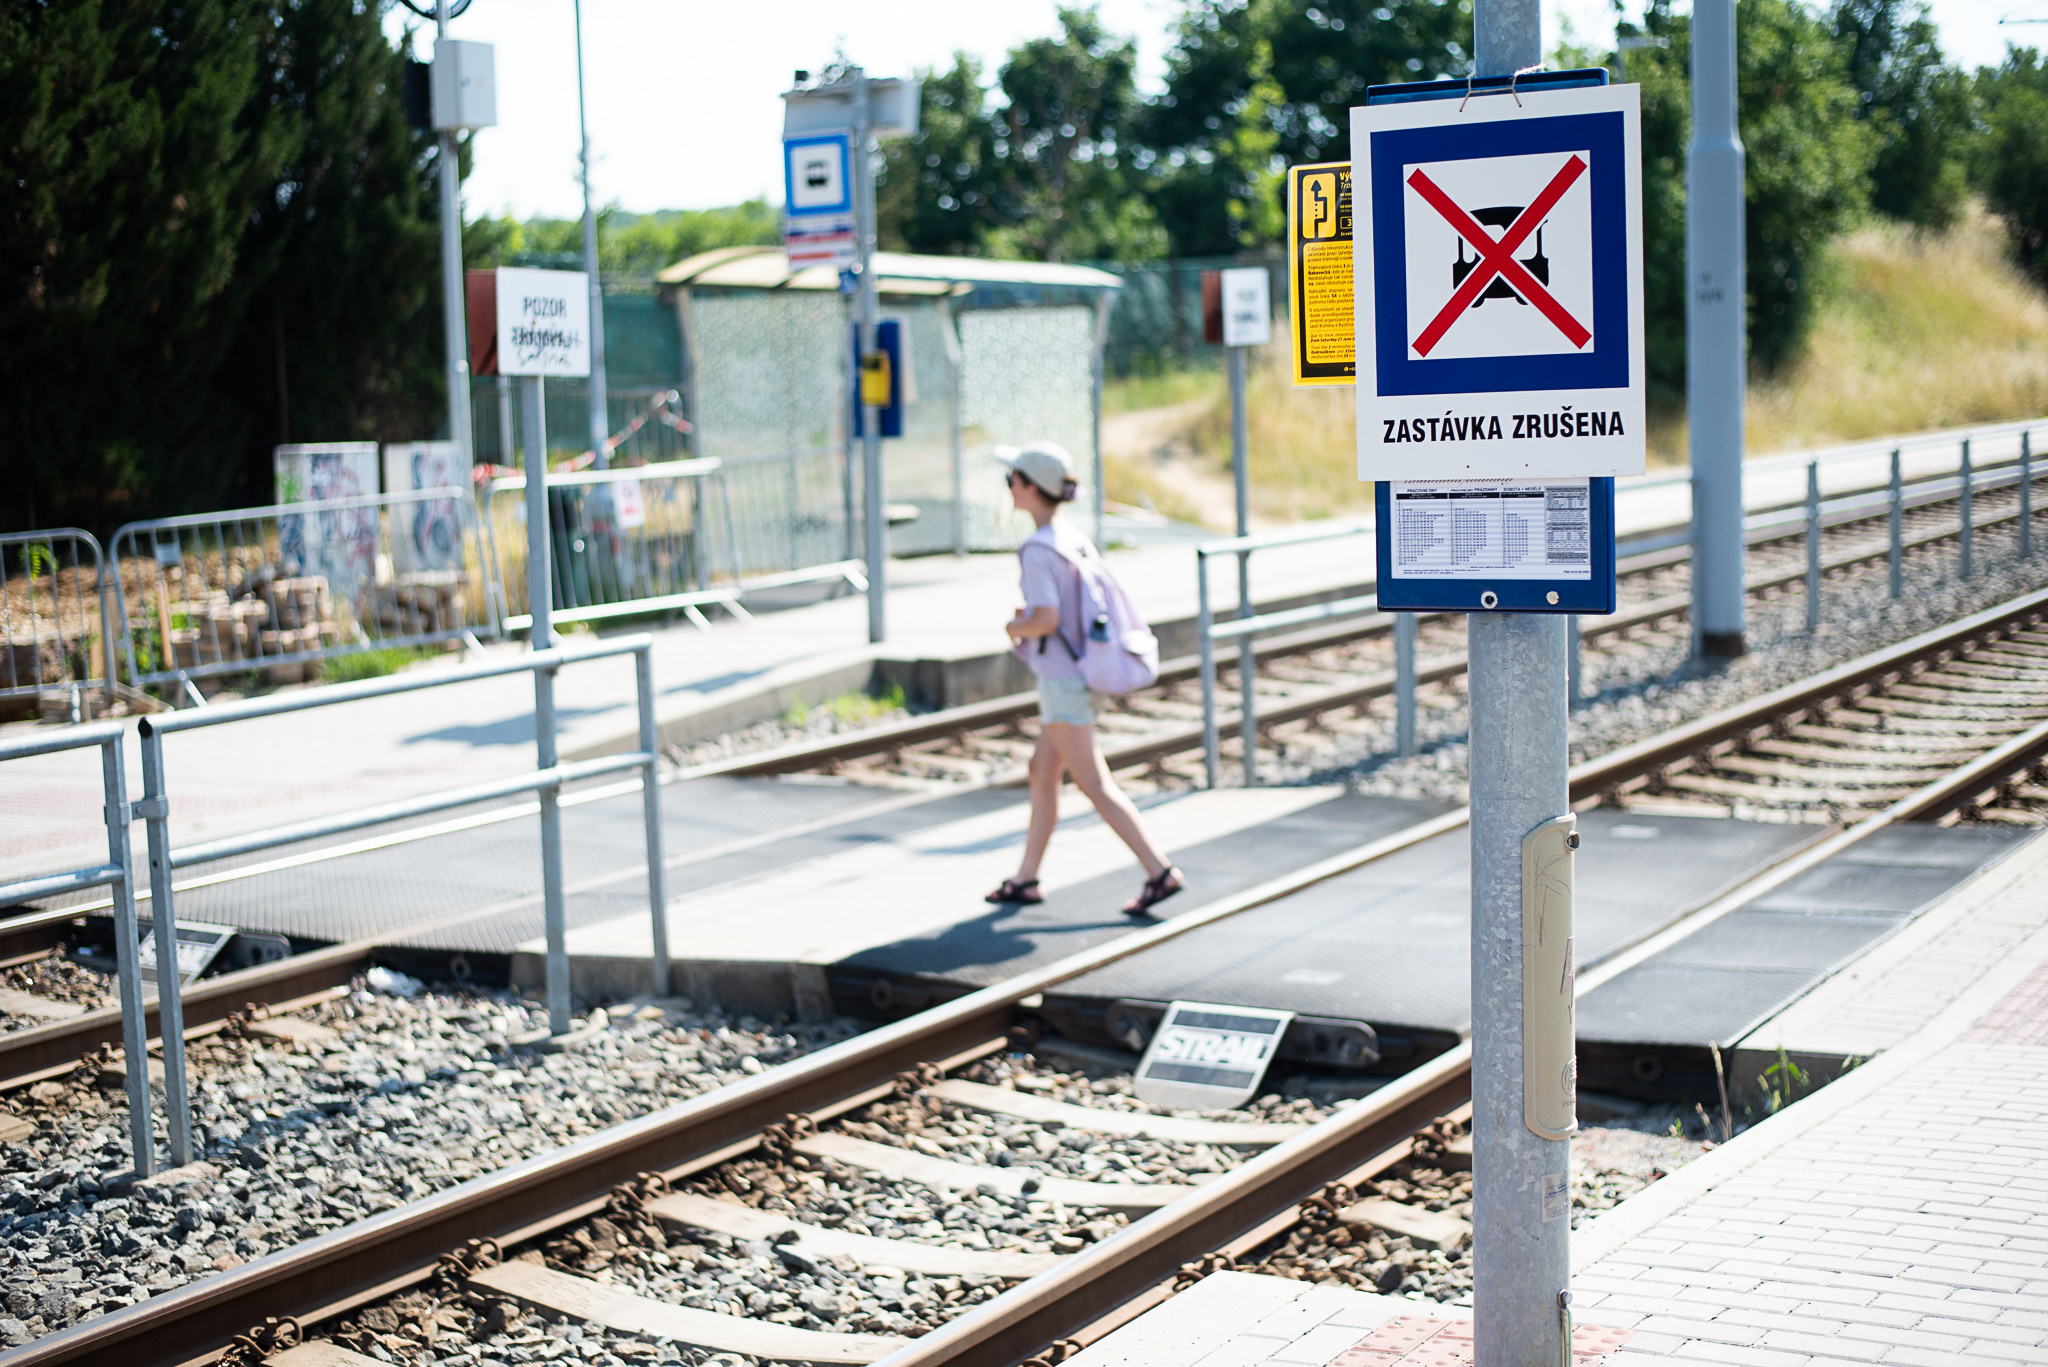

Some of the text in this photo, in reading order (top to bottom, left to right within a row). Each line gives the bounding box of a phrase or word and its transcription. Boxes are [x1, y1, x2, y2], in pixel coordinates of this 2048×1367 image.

[523, 296, 566, 317] POZOR
[1384, 406, 1625, 443] ZASTÁVKA ZRUŠENA
[1154, 1027, 1266, 1067] STRAIL
